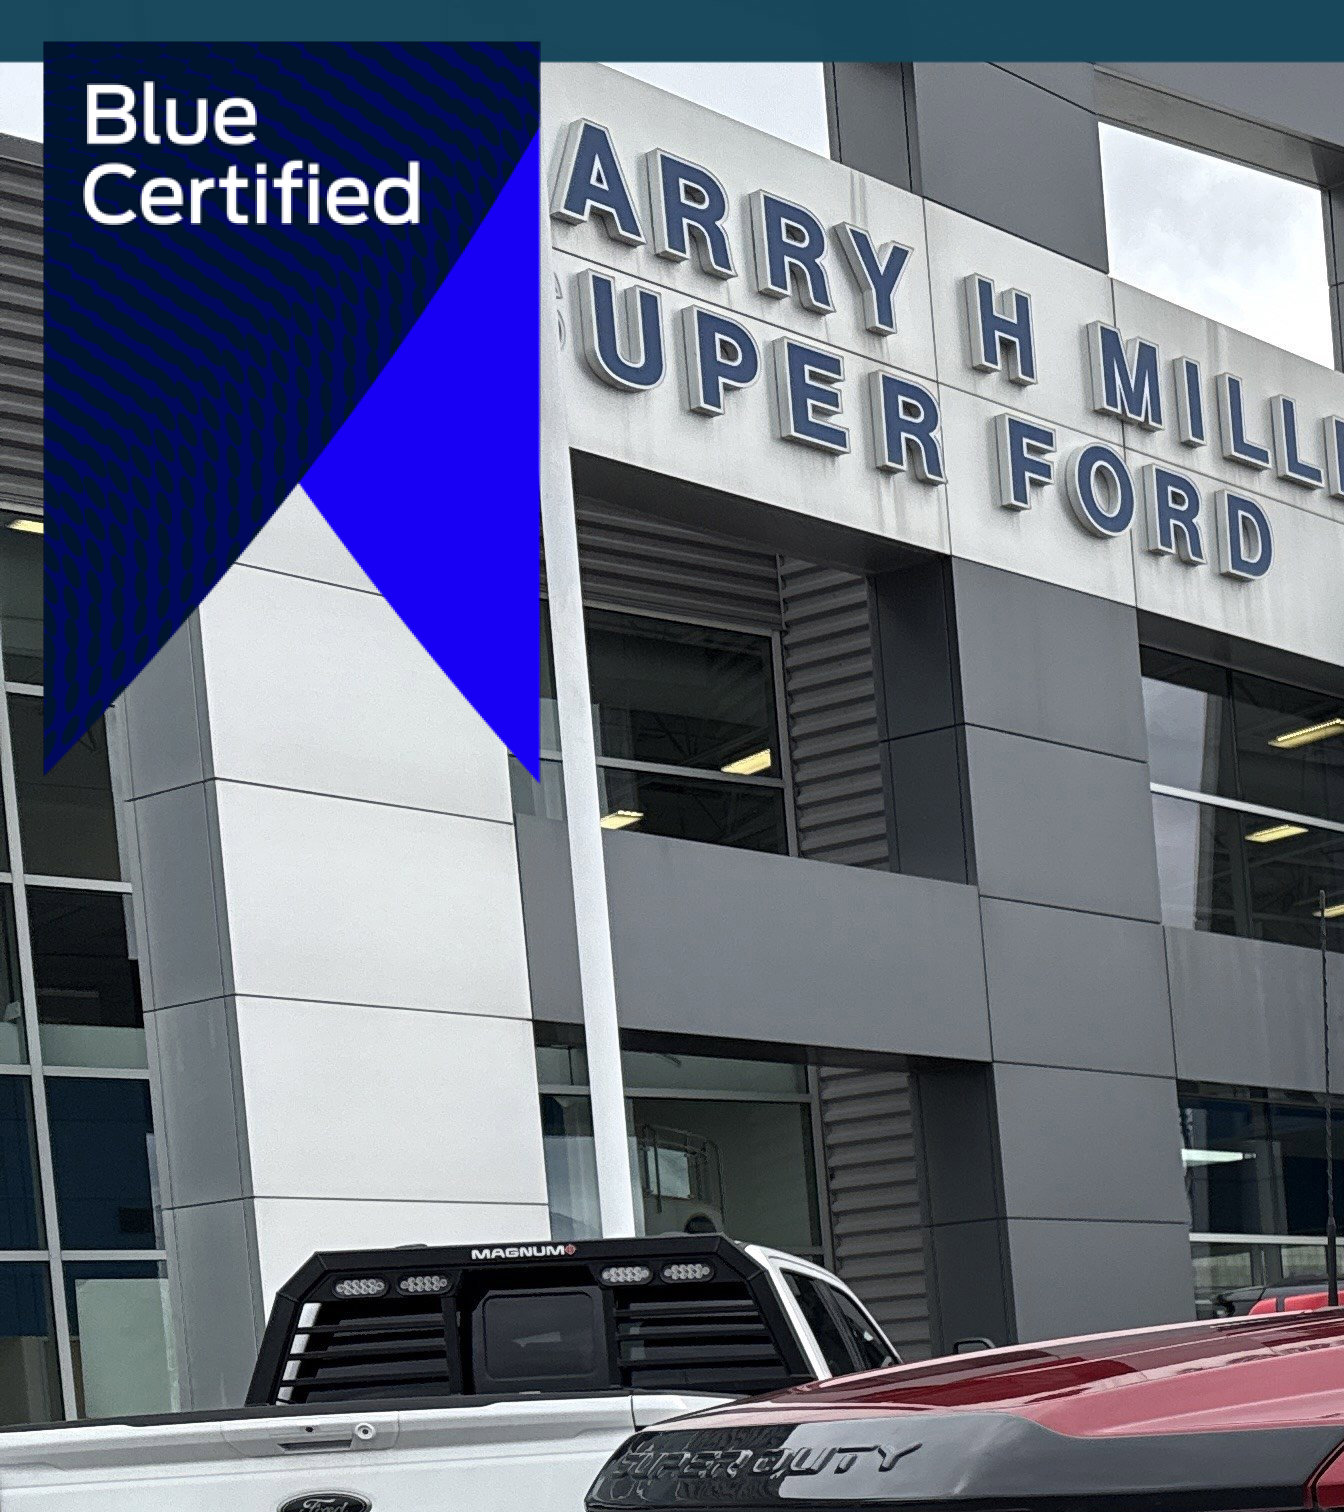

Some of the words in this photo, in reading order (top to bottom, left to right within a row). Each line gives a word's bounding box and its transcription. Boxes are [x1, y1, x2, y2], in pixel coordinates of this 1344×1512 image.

[551, 117, 914, 336] ARRY
[964, 272, 1038, 386] H
[555, 268, 947, 485] UPER
[995, 413, 1275, 582] FORD
[471, 1244, 565, 1260] MAGNUM
